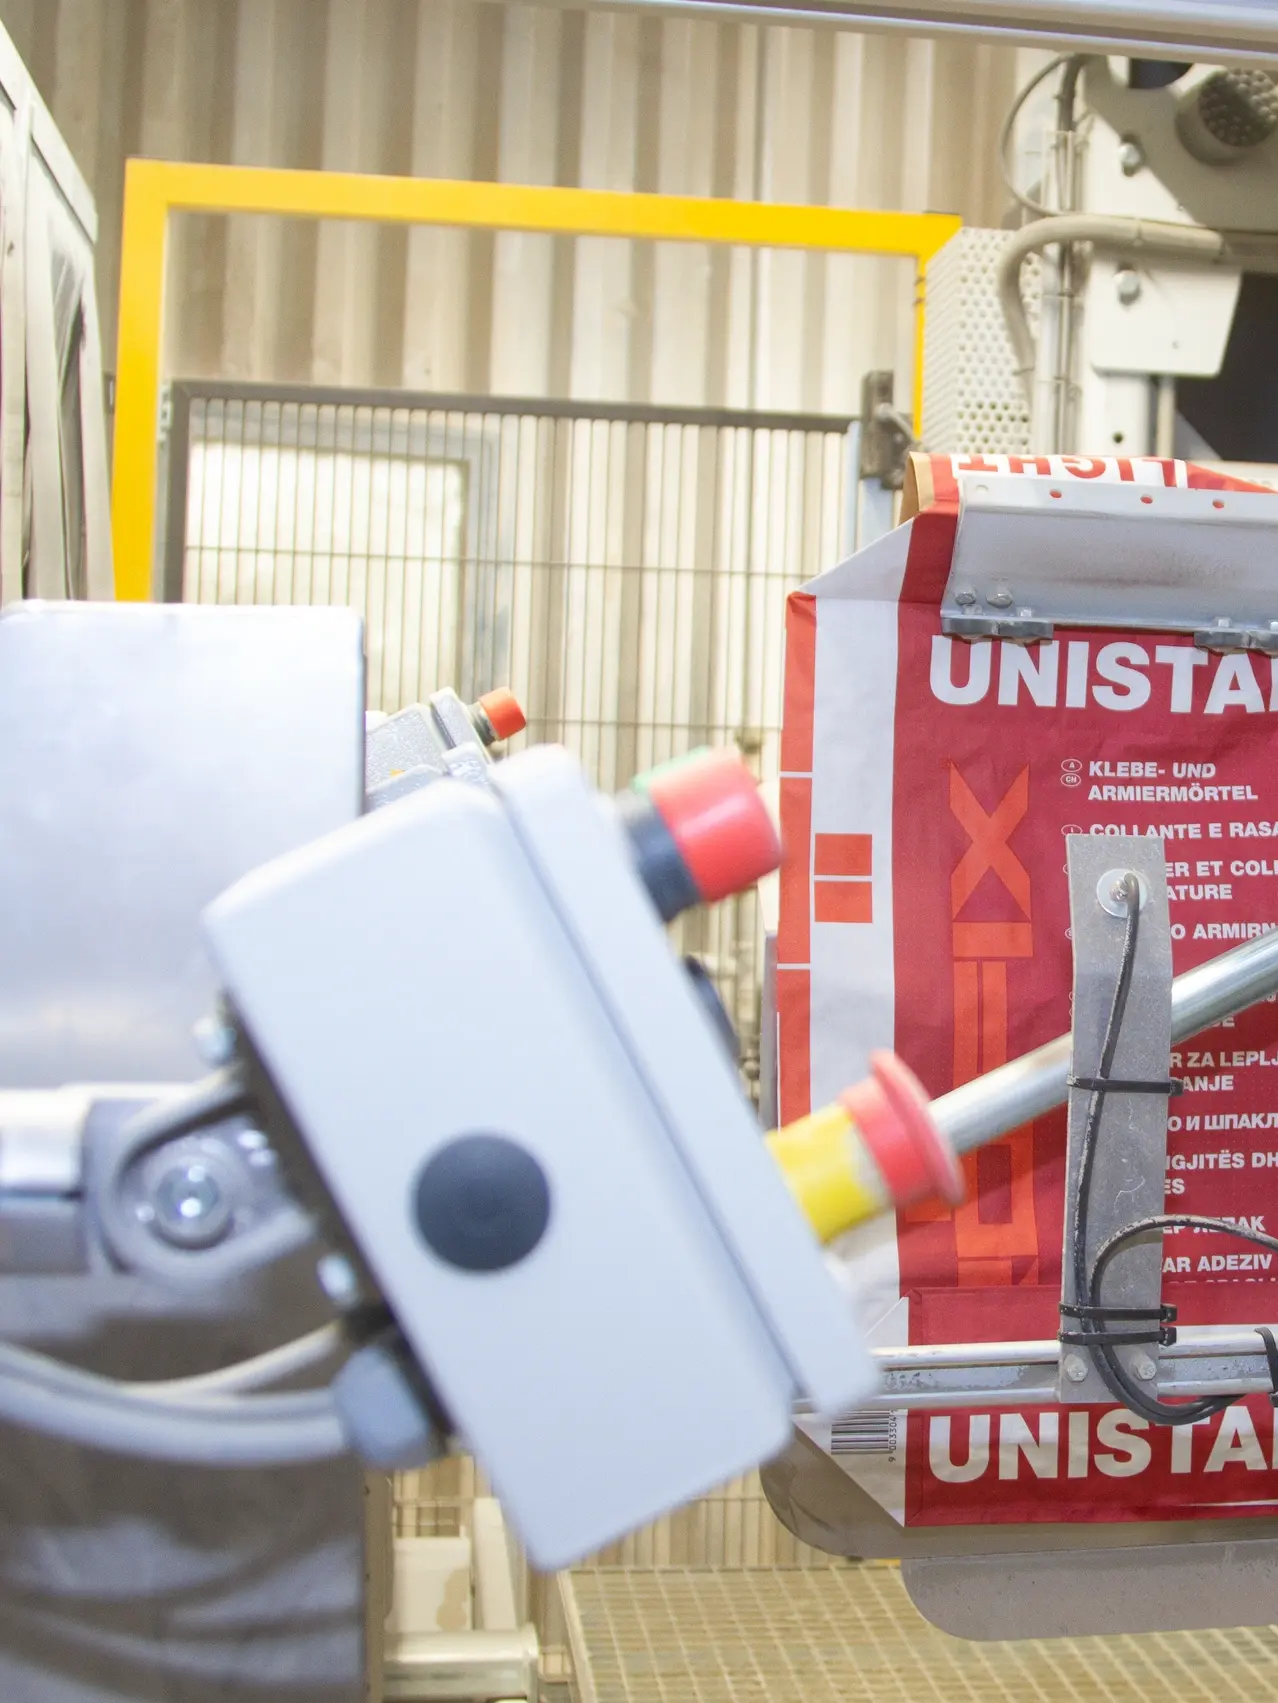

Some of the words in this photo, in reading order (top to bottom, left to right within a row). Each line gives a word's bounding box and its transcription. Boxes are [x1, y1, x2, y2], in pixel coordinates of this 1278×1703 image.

[1088, 761, 1165, 778] KLEBE-
[1172, 762, 1217, 779] UND
[1087, 782, 1259, 802] ARMIERMÖRTEL
[1089, 823, 1202, 839] COLLANTE
[1208, 823, 1222, 838] E
[1196, 860, 1223, 877] ET
[1187, 1052, 1215, 1068] ZA
[1172, 1075, 1234, 1092] ANJE
[1185, 1115, 1200, 1131] И
[1166, 1150, 1245, 1170] GJITËS
[1197, 1253, 1273, 1272] ADEZIV
